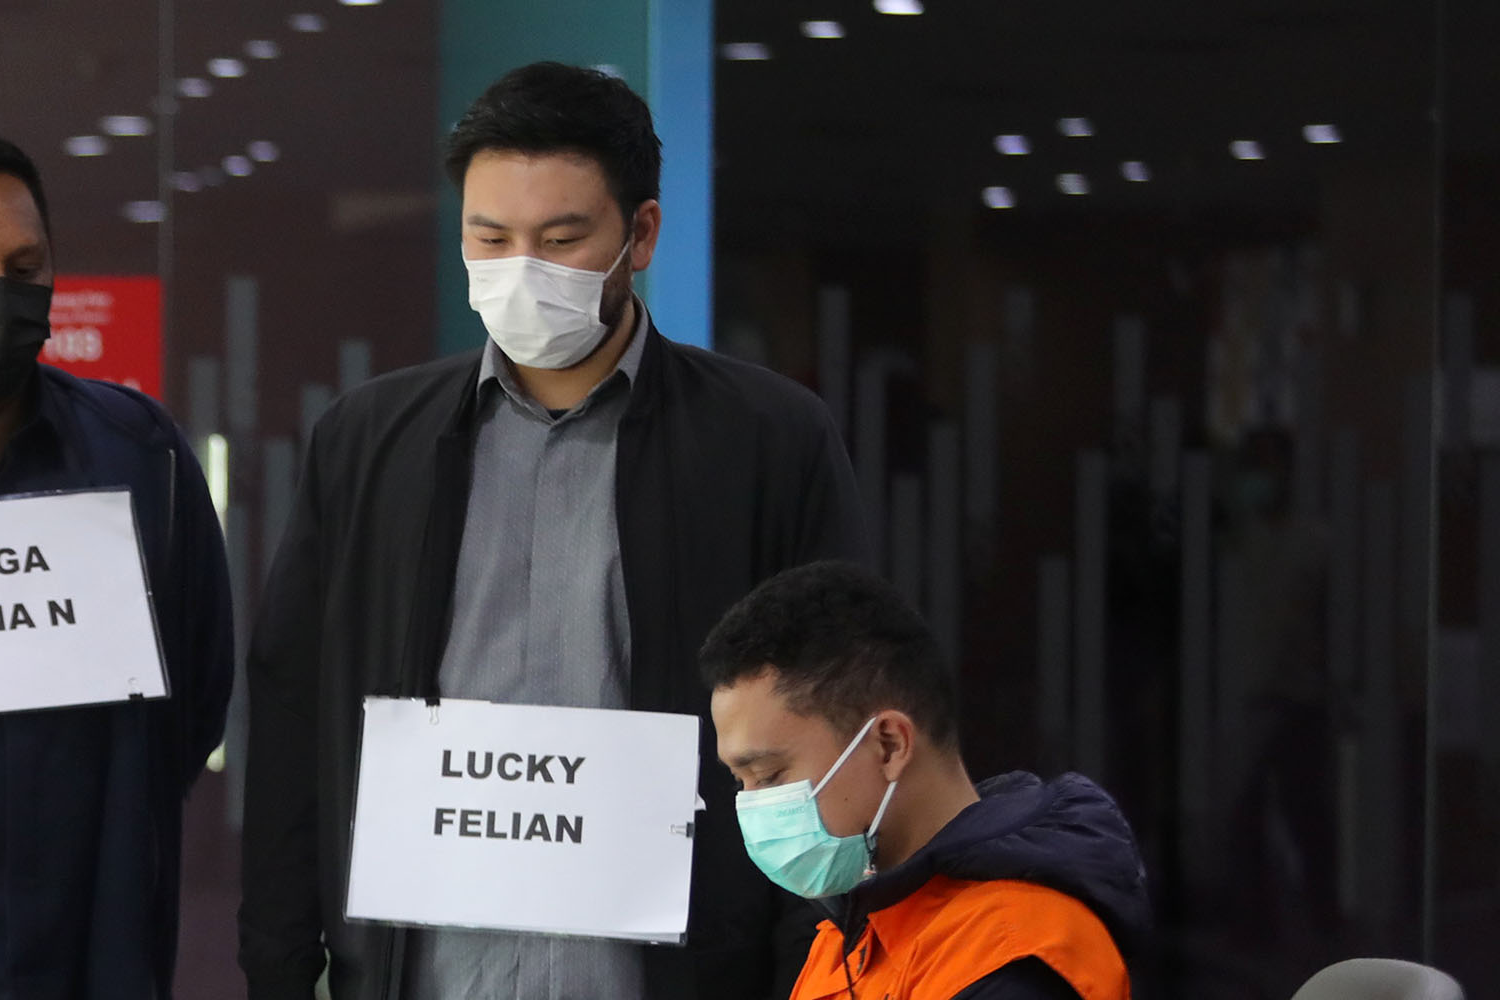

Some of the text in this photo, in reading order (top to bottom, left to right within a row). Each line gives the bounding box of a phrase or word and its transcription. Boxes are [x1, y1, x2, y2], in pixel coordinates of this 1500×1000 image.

[46, 598, 77, 627] N
[441, 749, 586, 785] LUCKY
[433, 807, 584, 844] FELIAN
